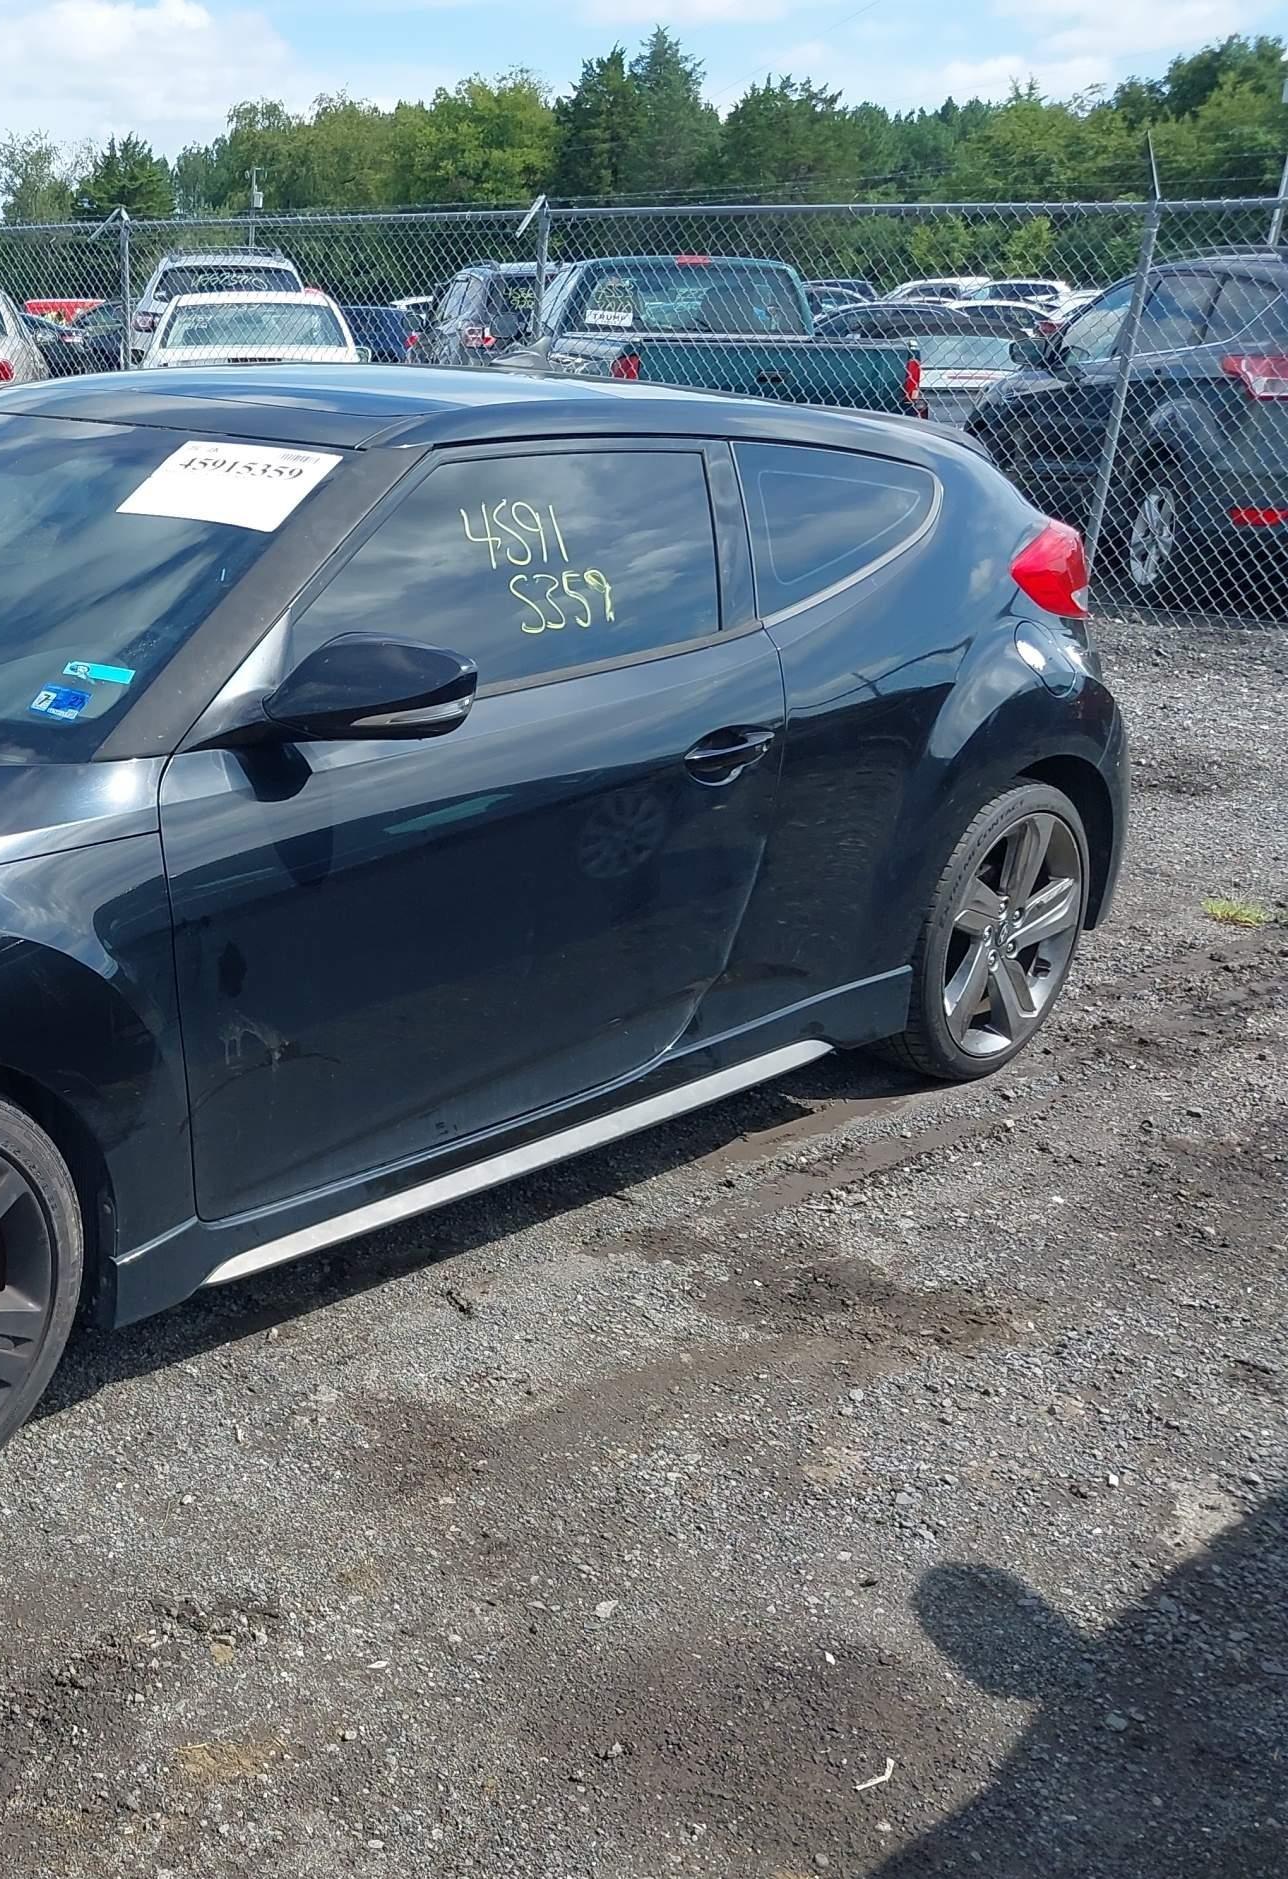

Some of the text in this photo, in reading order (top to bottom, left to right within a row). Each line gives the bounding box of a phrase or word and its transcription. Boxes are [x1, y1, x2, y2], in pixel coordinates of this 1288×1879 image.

[179, 457, 304, 481] 45915359
[460, 499, 569, 569] 4591
[509, 569, 615, 634] 5359
